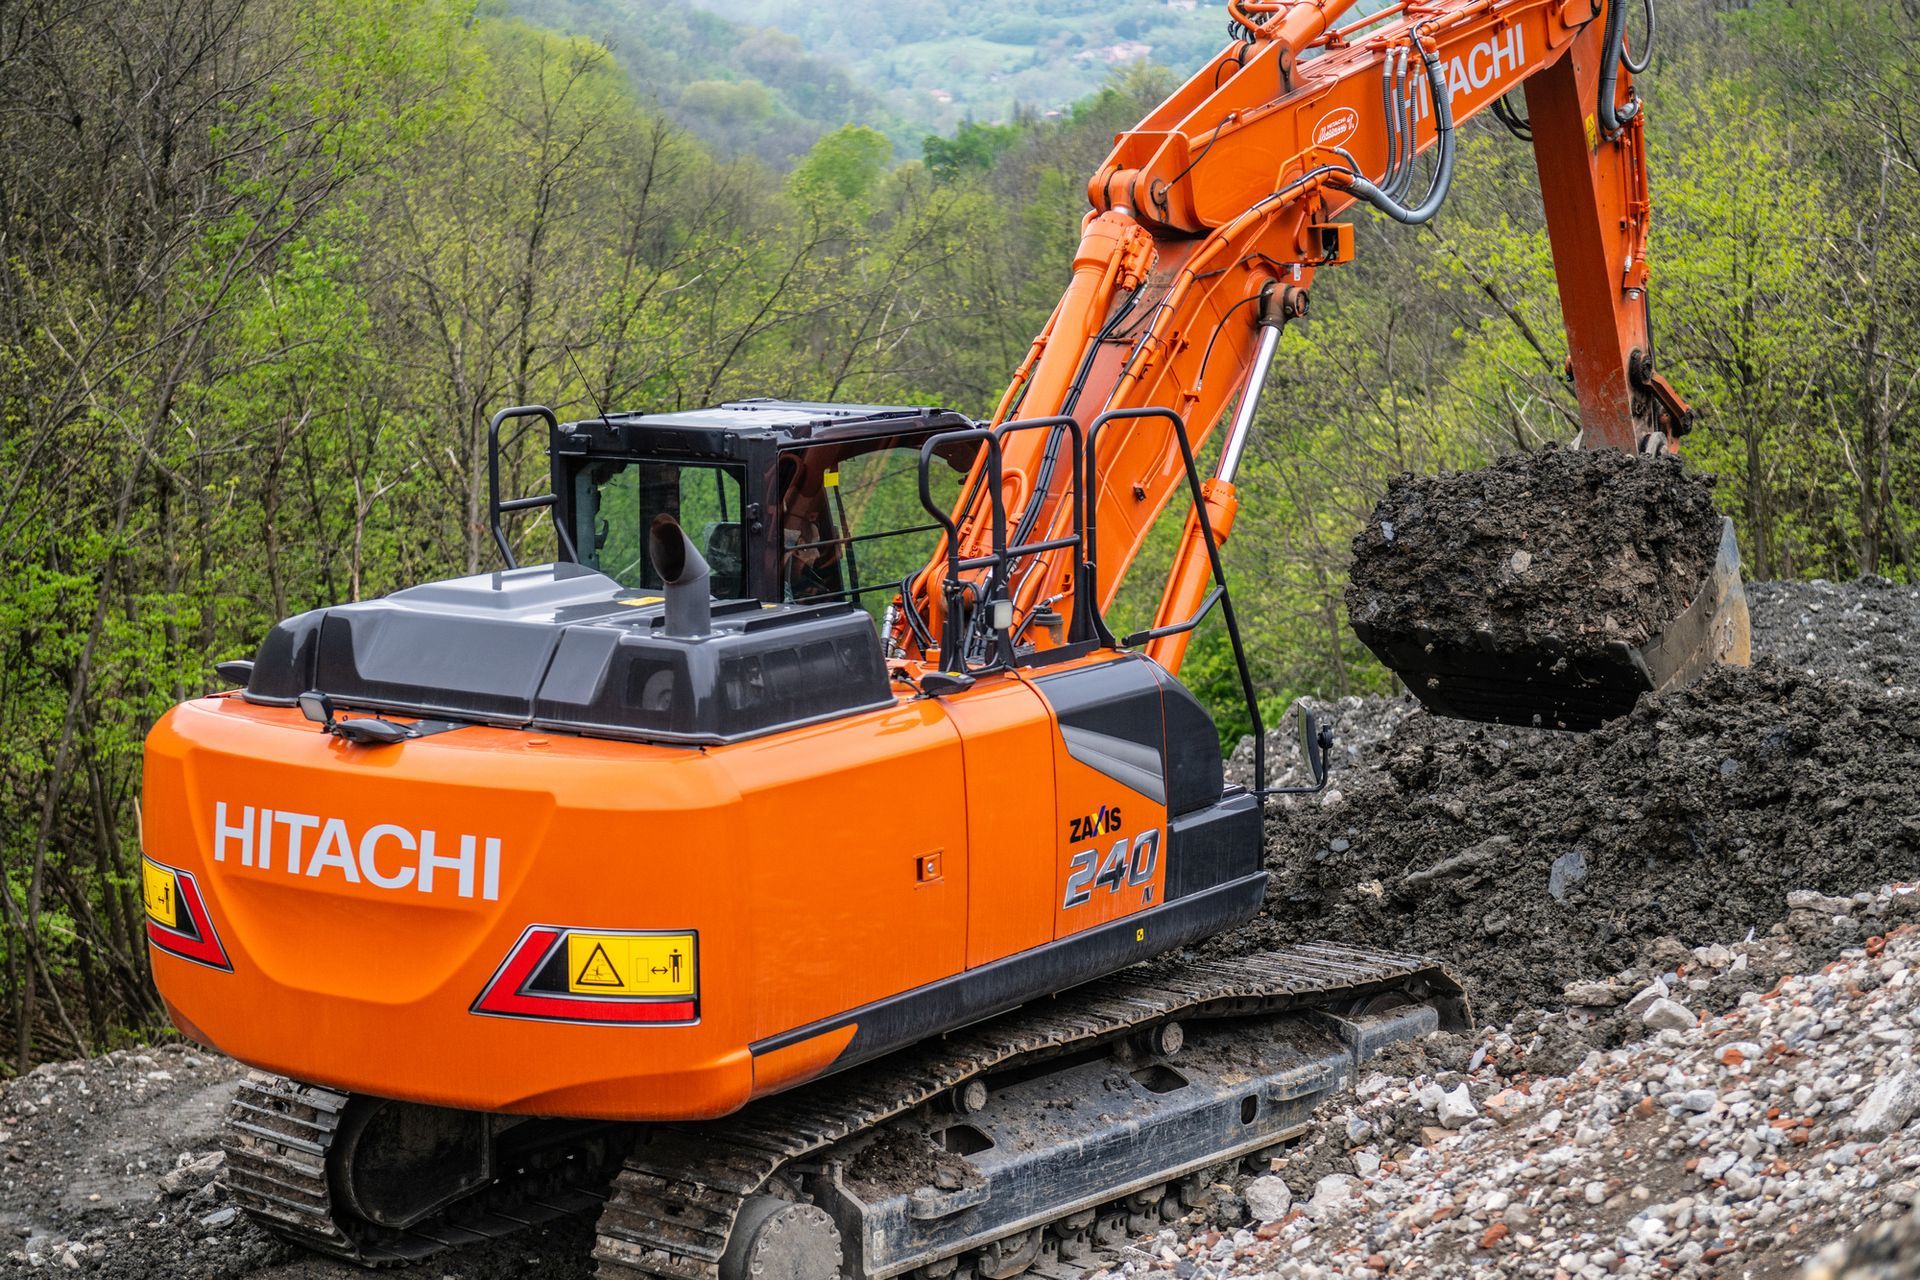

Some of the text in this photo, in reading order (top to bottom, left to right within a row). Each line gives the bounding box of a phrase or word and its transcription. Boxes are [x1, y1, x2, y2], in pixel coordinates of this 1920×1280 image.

[1392, 23, 1525, 133] HIACHI
[215, 801, 501, 900] HITACHI
[1063, 828, 1160, 909] 240
[1070, 805, 1122, 843] ZAXIS
